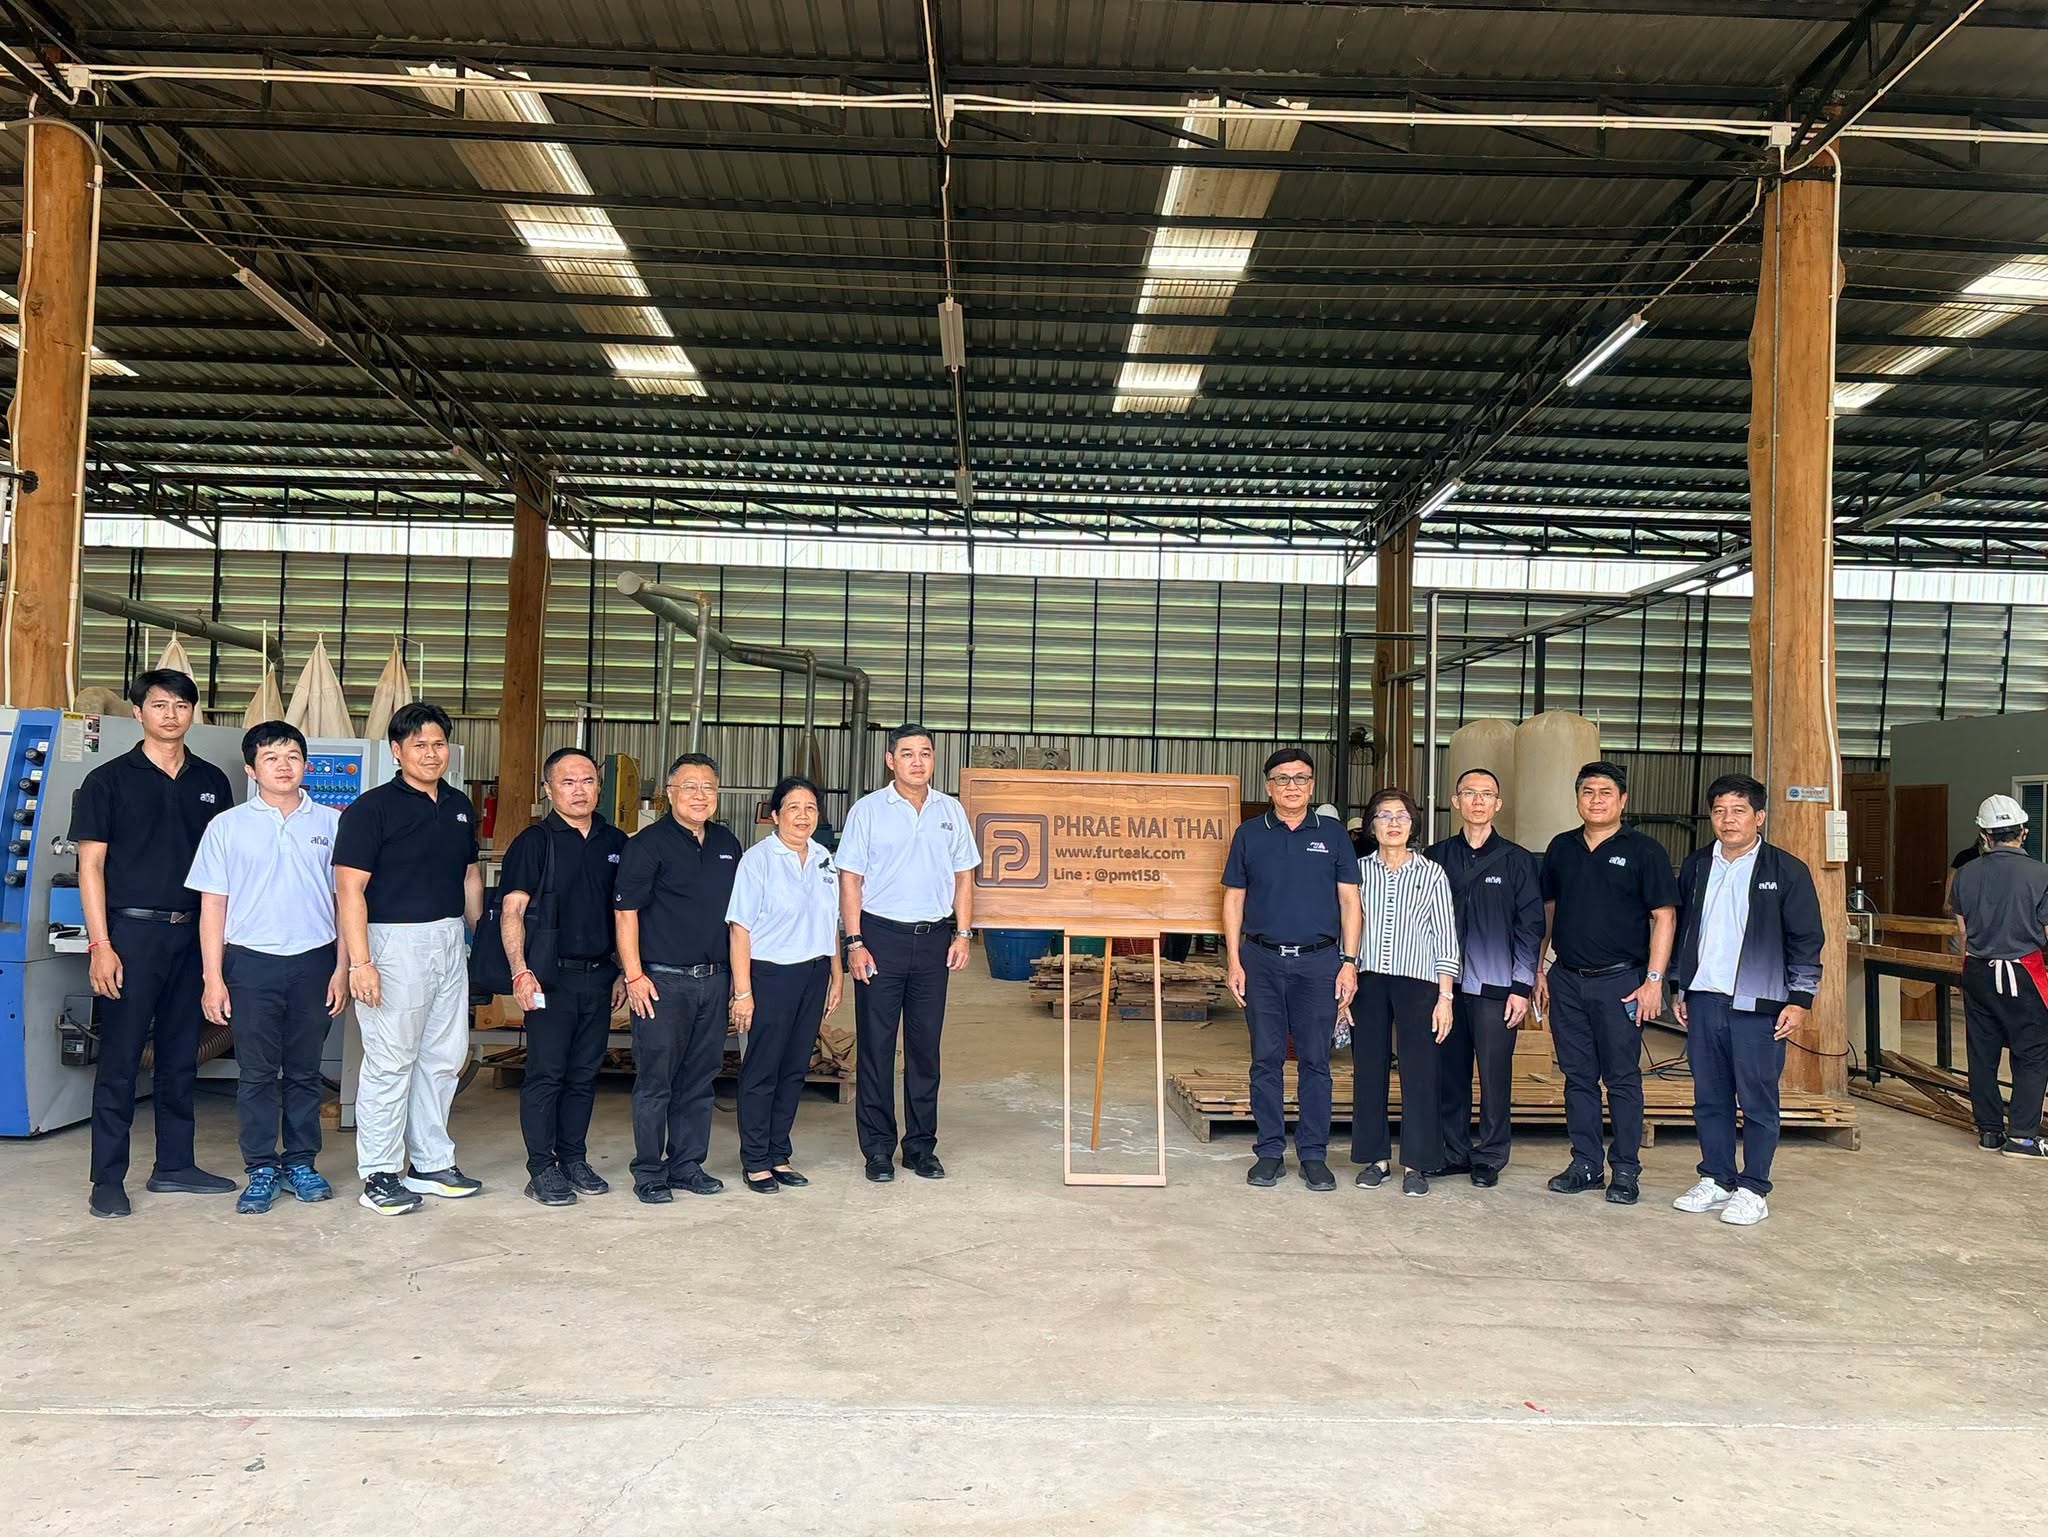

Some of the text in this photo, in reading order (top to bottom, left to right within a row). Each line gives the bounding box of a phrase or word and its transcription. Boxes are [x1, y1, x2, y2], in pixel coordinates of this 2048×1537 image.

[1053, 815, 1223, 840] PHRAE MAI THAI
[1055, 845, 1186, 860] www.furteak.com
[1053, 868, 1083, 881] Line
[1094, 869, 1161, 884] @pmt158
